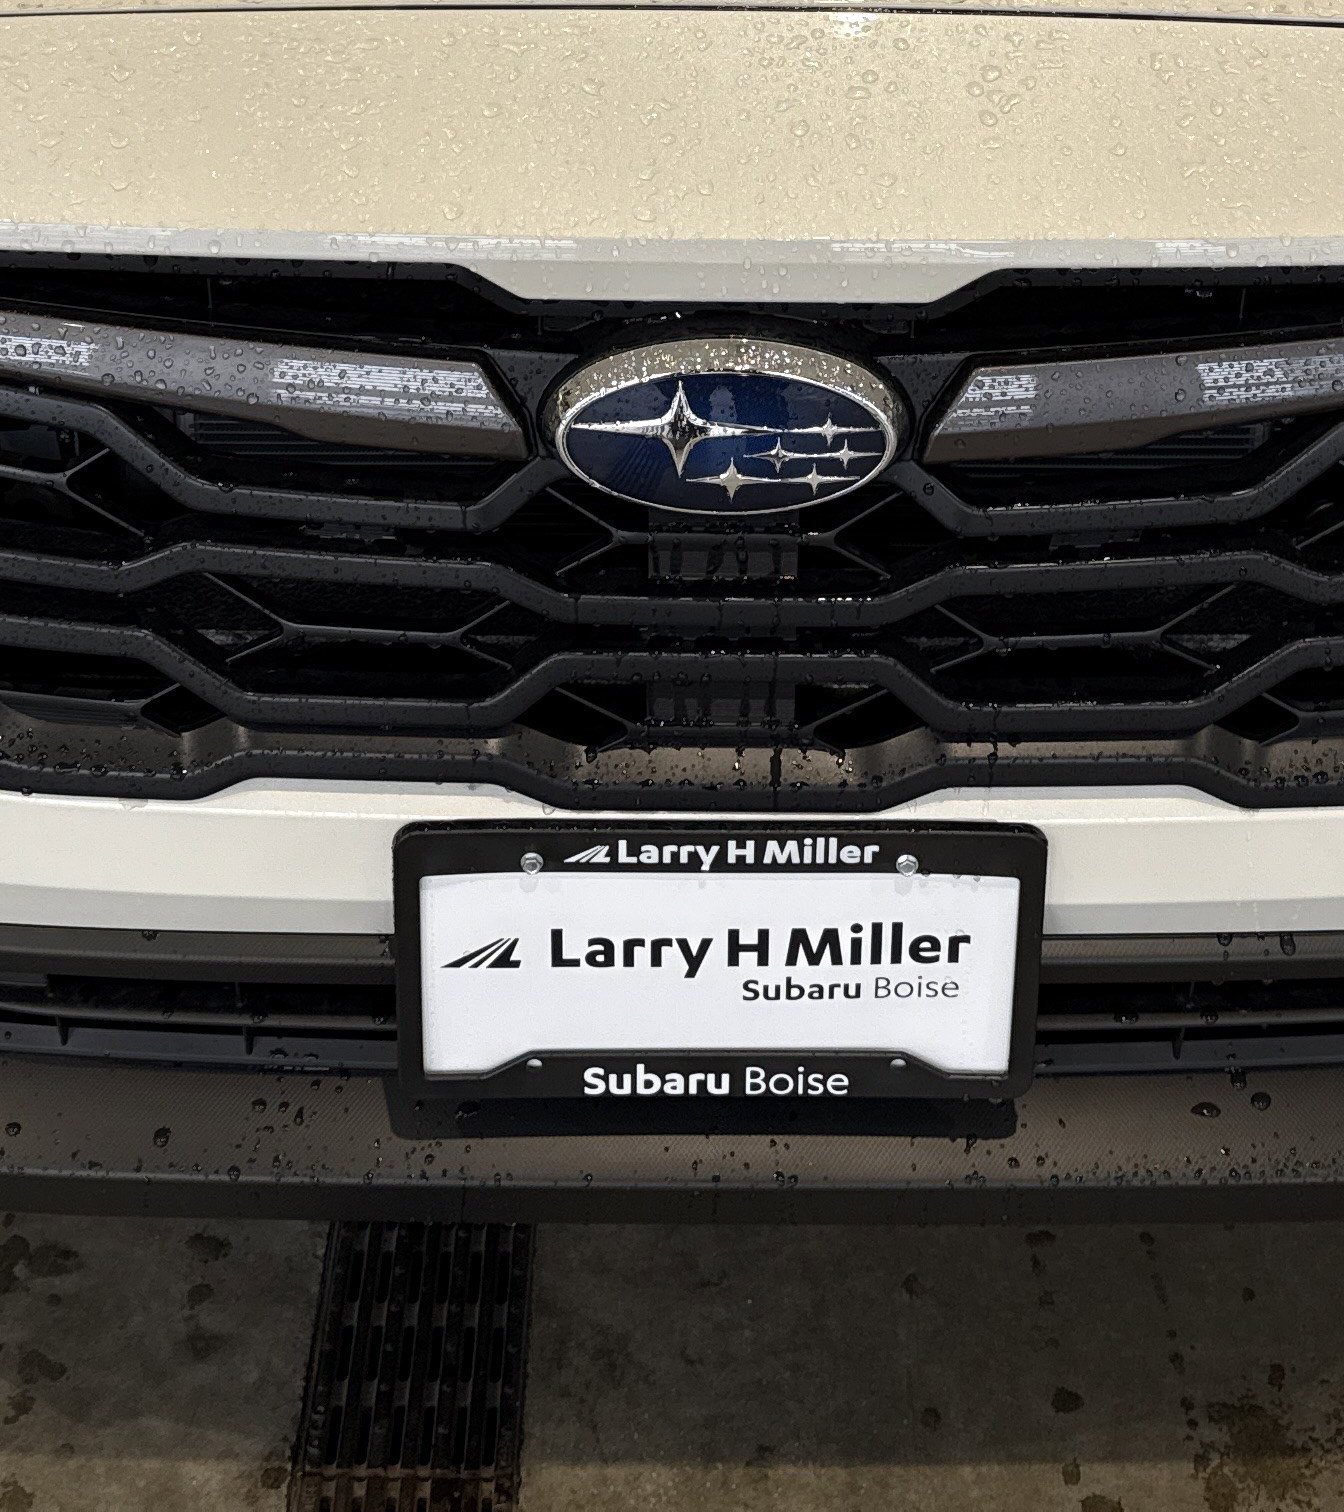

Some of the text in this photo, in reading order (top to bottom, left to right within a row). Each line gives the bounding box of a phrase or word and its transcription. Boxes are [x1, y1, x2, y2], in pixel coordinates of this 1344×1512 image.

[617, 836, 880, 872] Larry H Miller
[550, 921, 971, 979] Larry H Miller
[742, 976, 960, 1002] Subaru Boise
[583, 1064, 850, 1096] Subaru Boise
